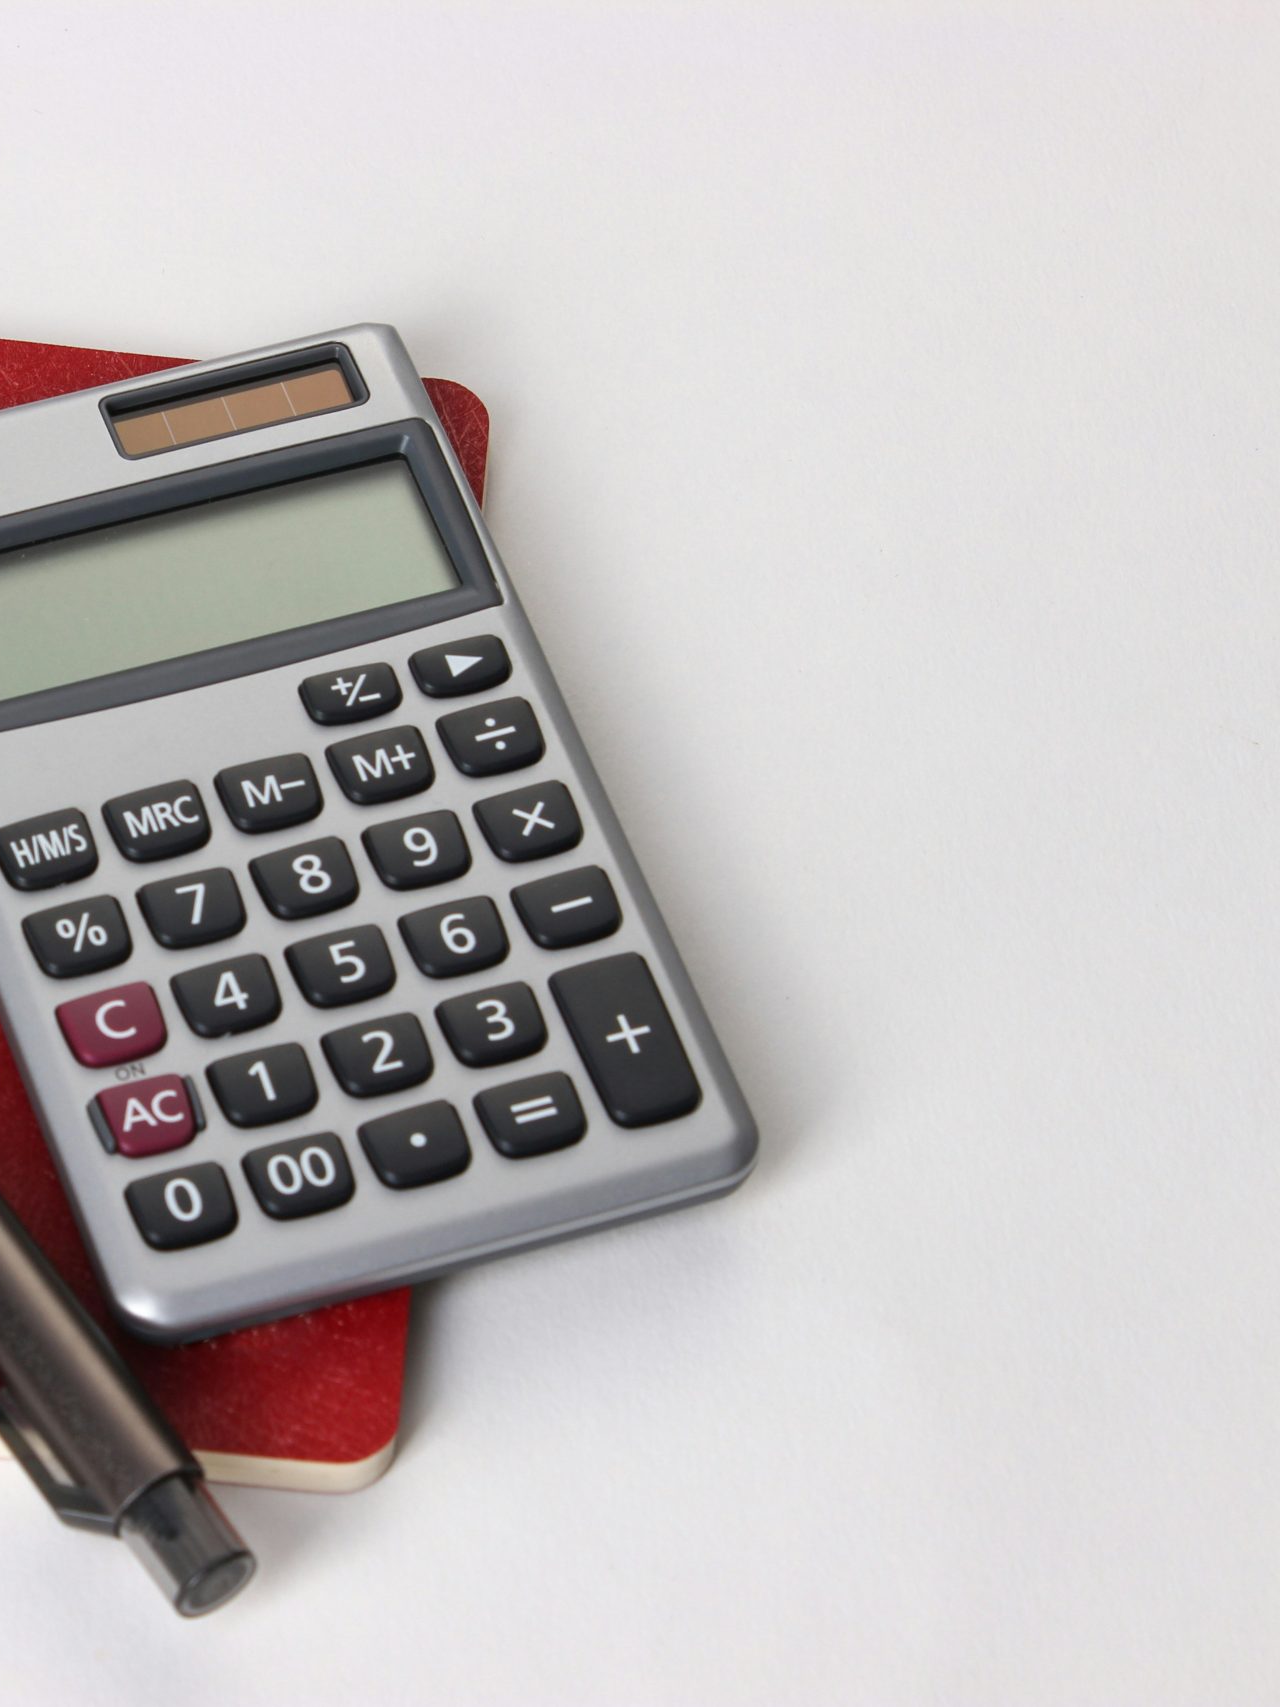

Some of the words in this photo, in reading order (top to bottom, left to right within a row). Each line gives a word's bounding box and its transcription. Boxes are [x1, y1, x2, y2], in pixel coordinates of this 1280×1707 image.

[351, 744, 416, 782] M+
[122, 795, 200, 839] MRC
[9, 823, 88, 869] H/M/S
[403, 827, 438, 867] 9
[292, 854, 331, 894] 8
[175, 883, 205, 925] 7
[55, 912, 107, 952] %
[440, 913, 476, 954] 6
[329, 940, 366, 983] 5
[214, 971, 248, 1010] 4
[95, 1000, 136, 1039] C
[476, 999, 515, 1041] 3
[606, 1014, 650, 1054] +
[114, 1062, 147, 1081] ON
[361, 1030, 403, 1073] 2
[248, 1061, 276, 1100] 1
[123, 1090, 184, 1132] AC
[510, 1096, 557, 1124] =
[267, 1146, 336, 1196] 00
[164, 1178, 202, 1221] 0
